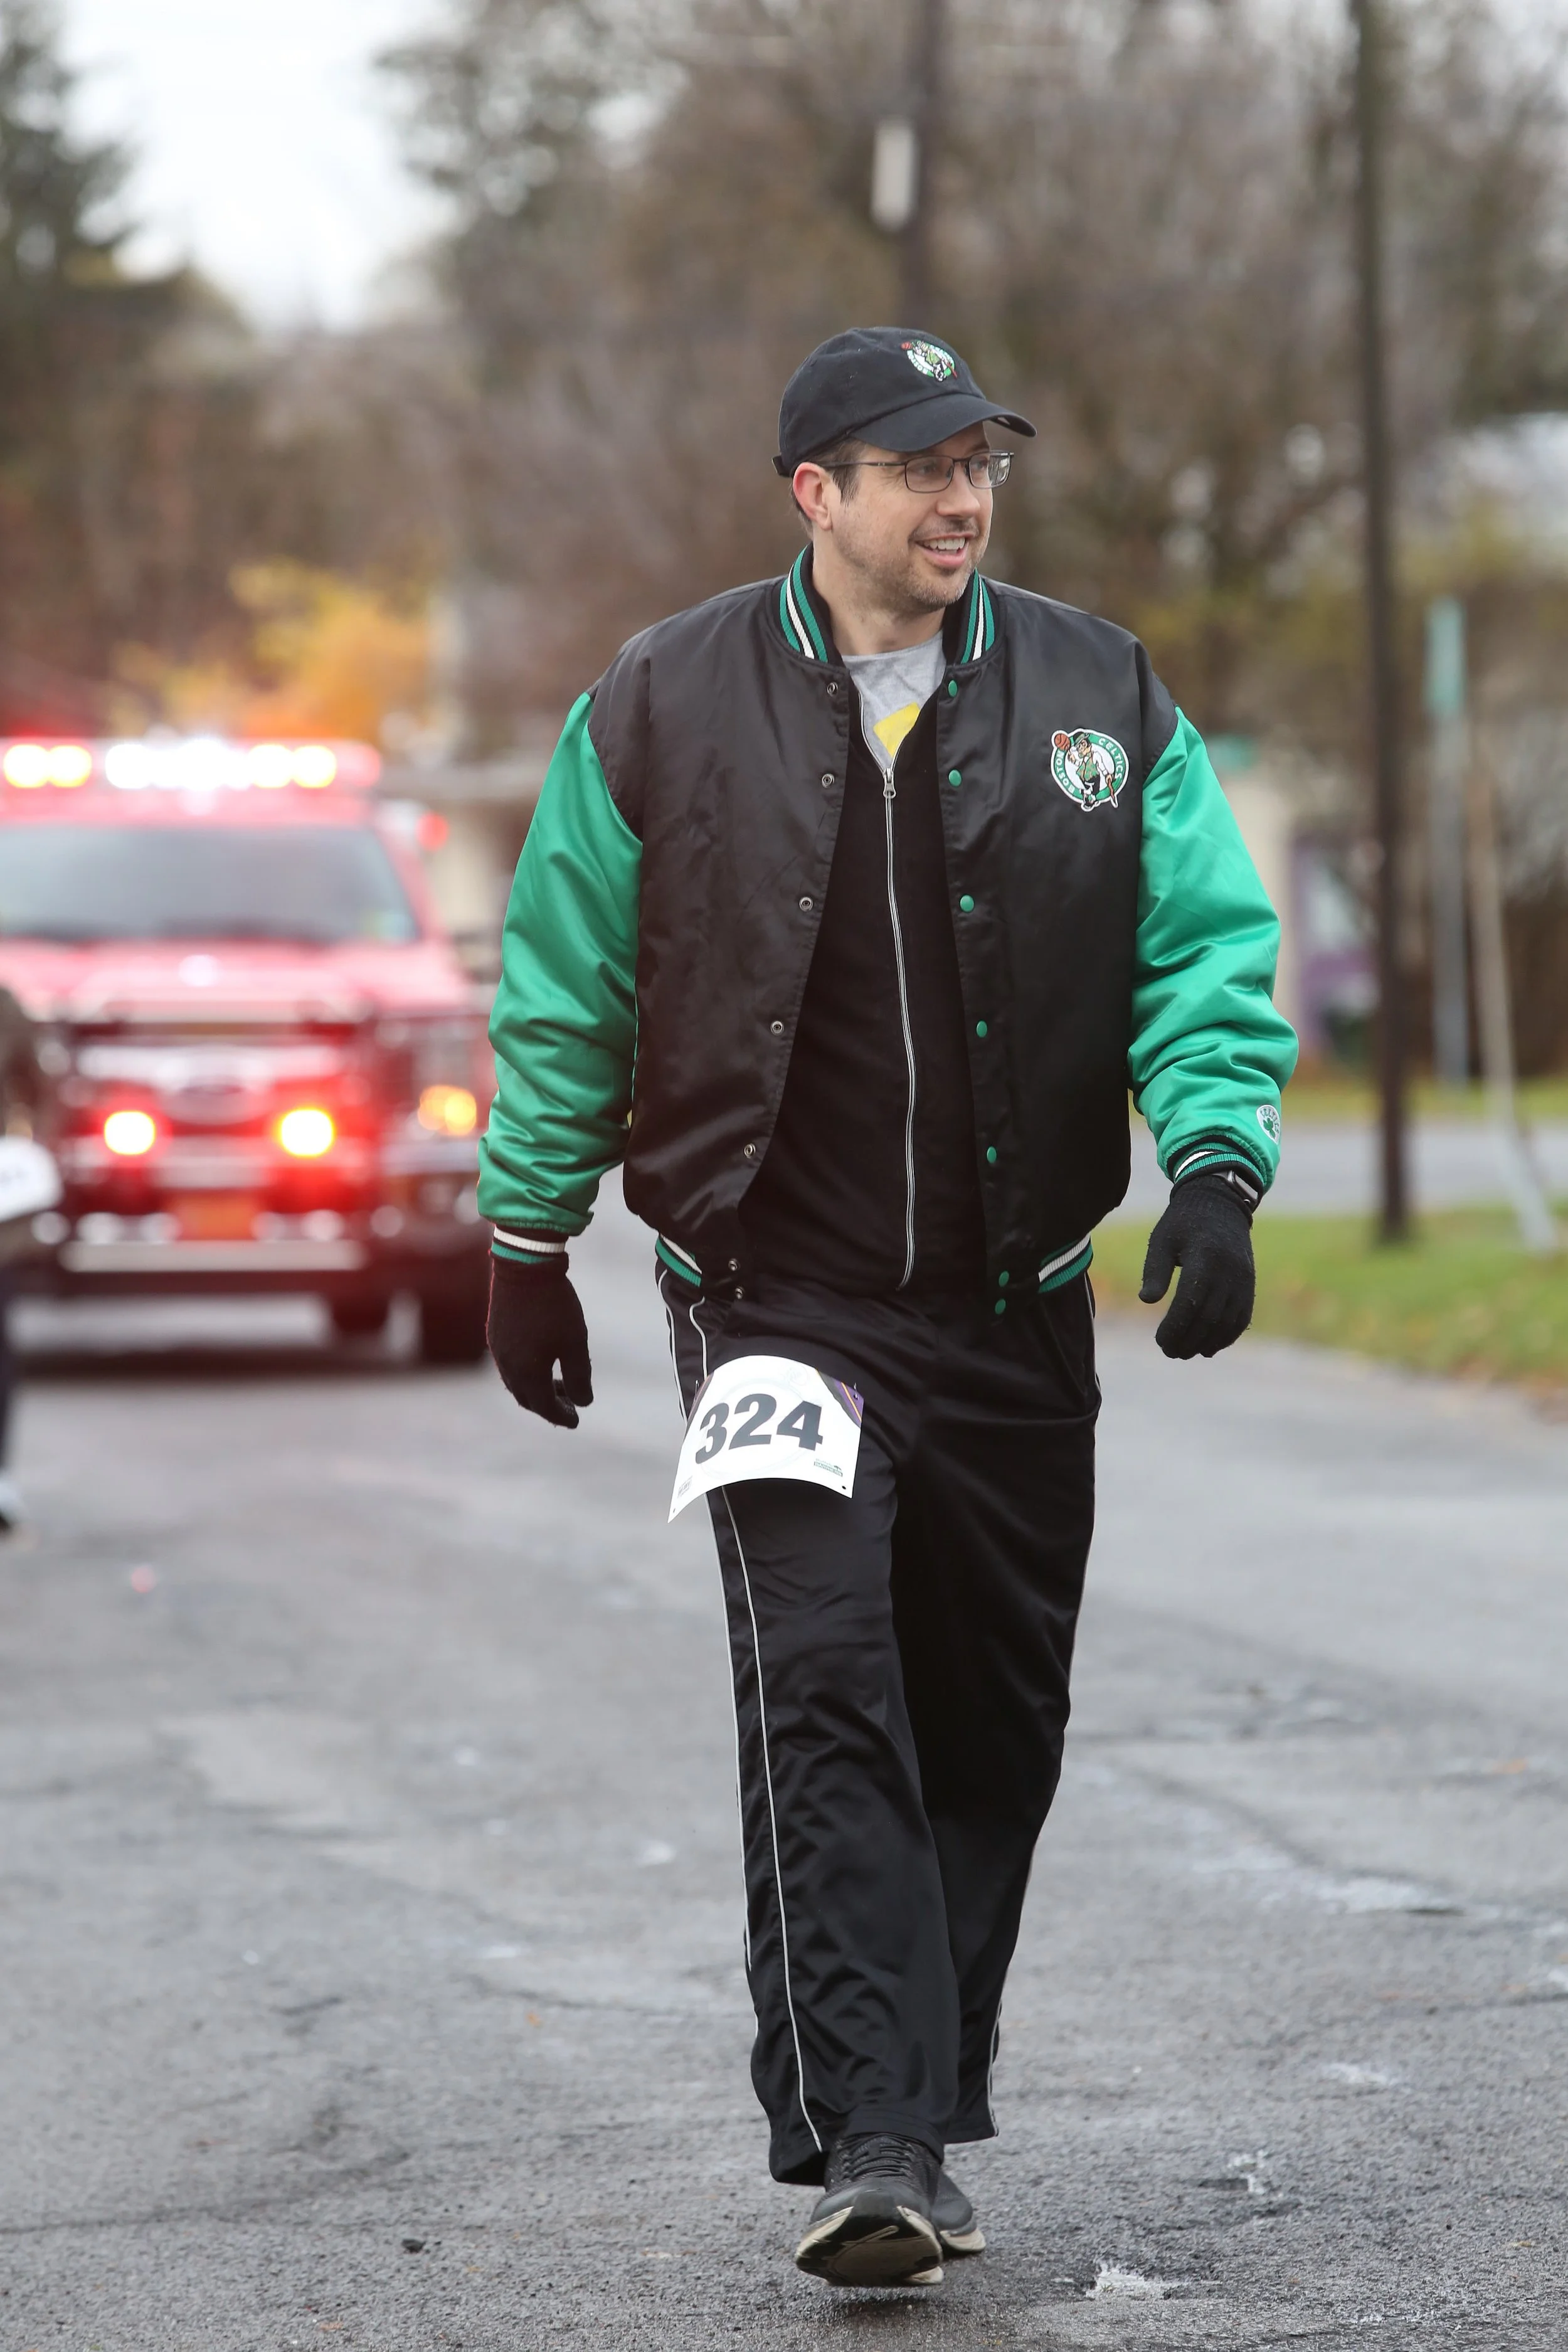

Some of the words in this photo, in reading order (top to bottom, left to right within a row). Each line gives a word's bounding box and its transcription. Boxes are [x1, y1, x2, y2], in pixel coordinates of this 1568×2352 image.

[1056, 750, 1075, 793] BOSTON
[1098, 738, 1124, 780] CELTICS
[696, 1393, 824, 1464] 324
